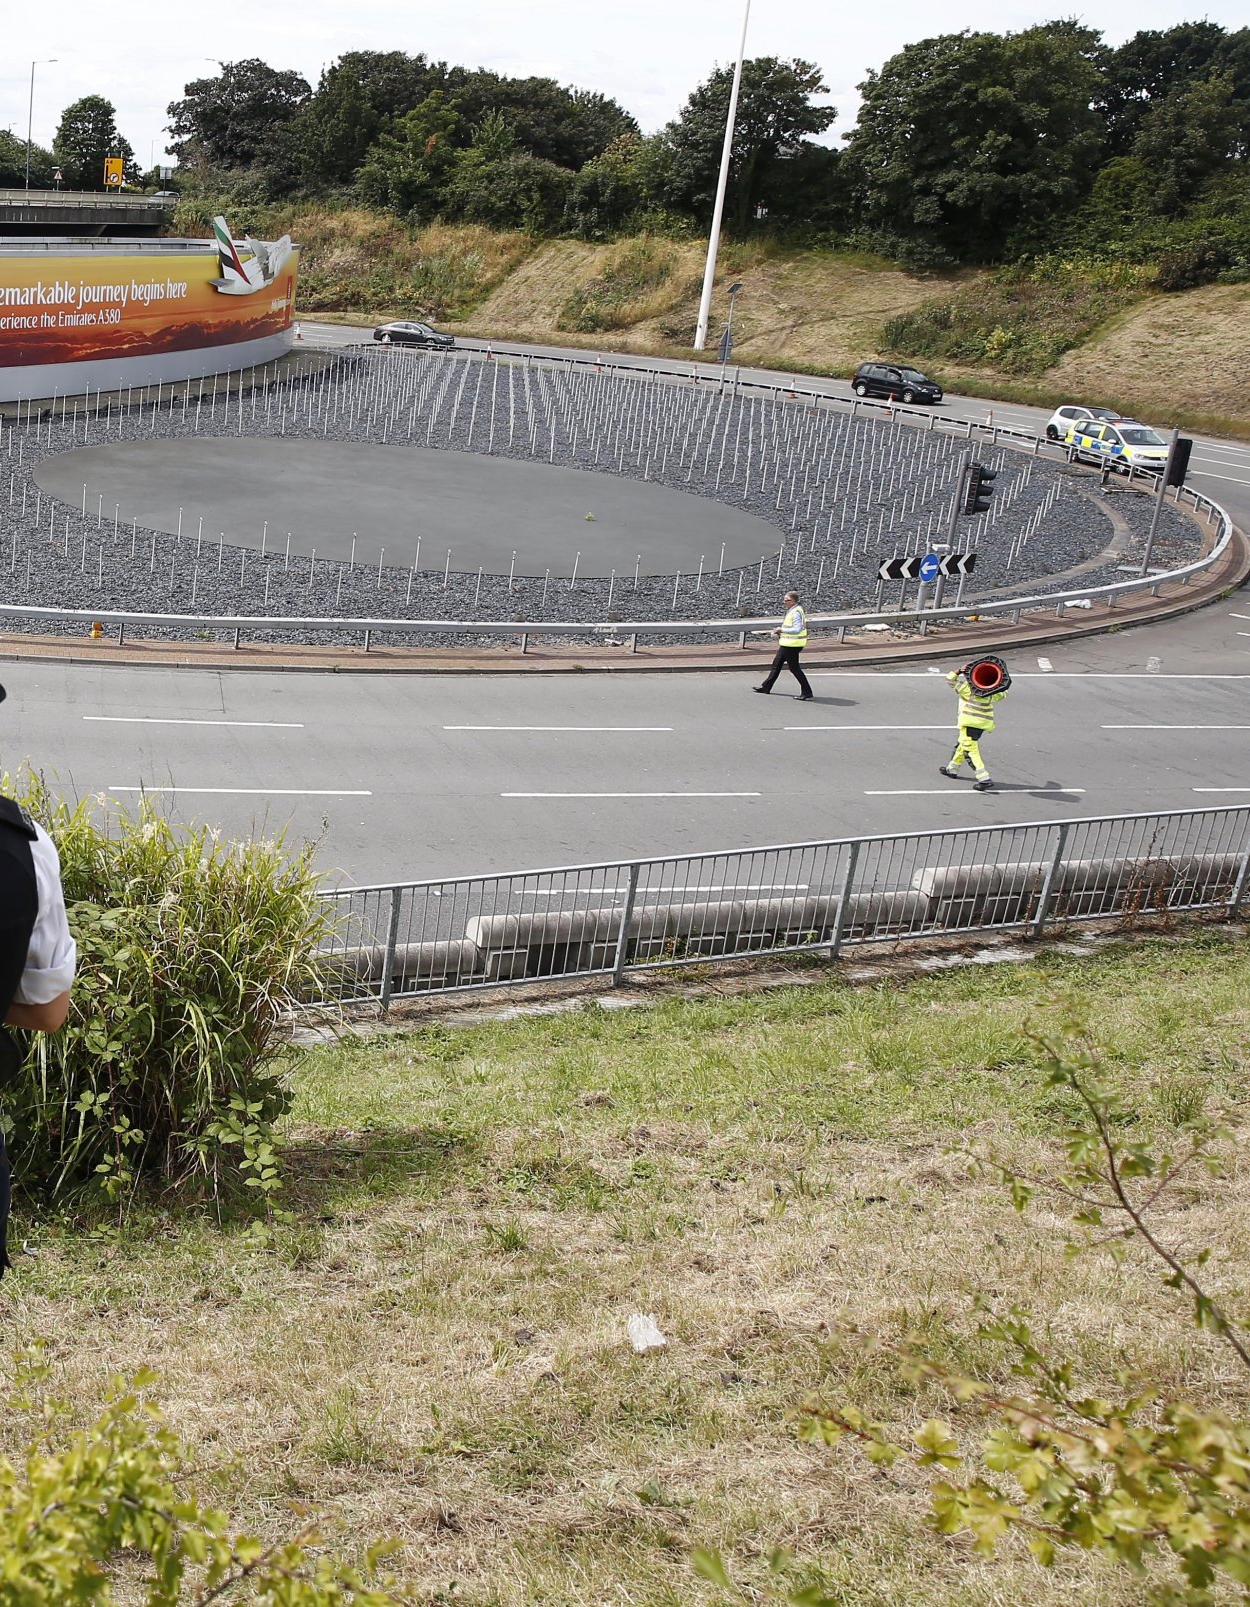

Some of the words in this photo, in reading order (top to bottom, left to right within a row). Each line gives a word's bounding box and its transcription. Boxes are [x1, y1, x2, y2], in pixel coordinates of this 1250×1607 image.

[77, 281, 127, 312] journey
[131, 279, 165, 308] begins
[166, 278, 187, 299] here
[41, 311, 56, 328] the
[58, 310, 97, 327] Emirates
[98, 308, 121, 325] A380
